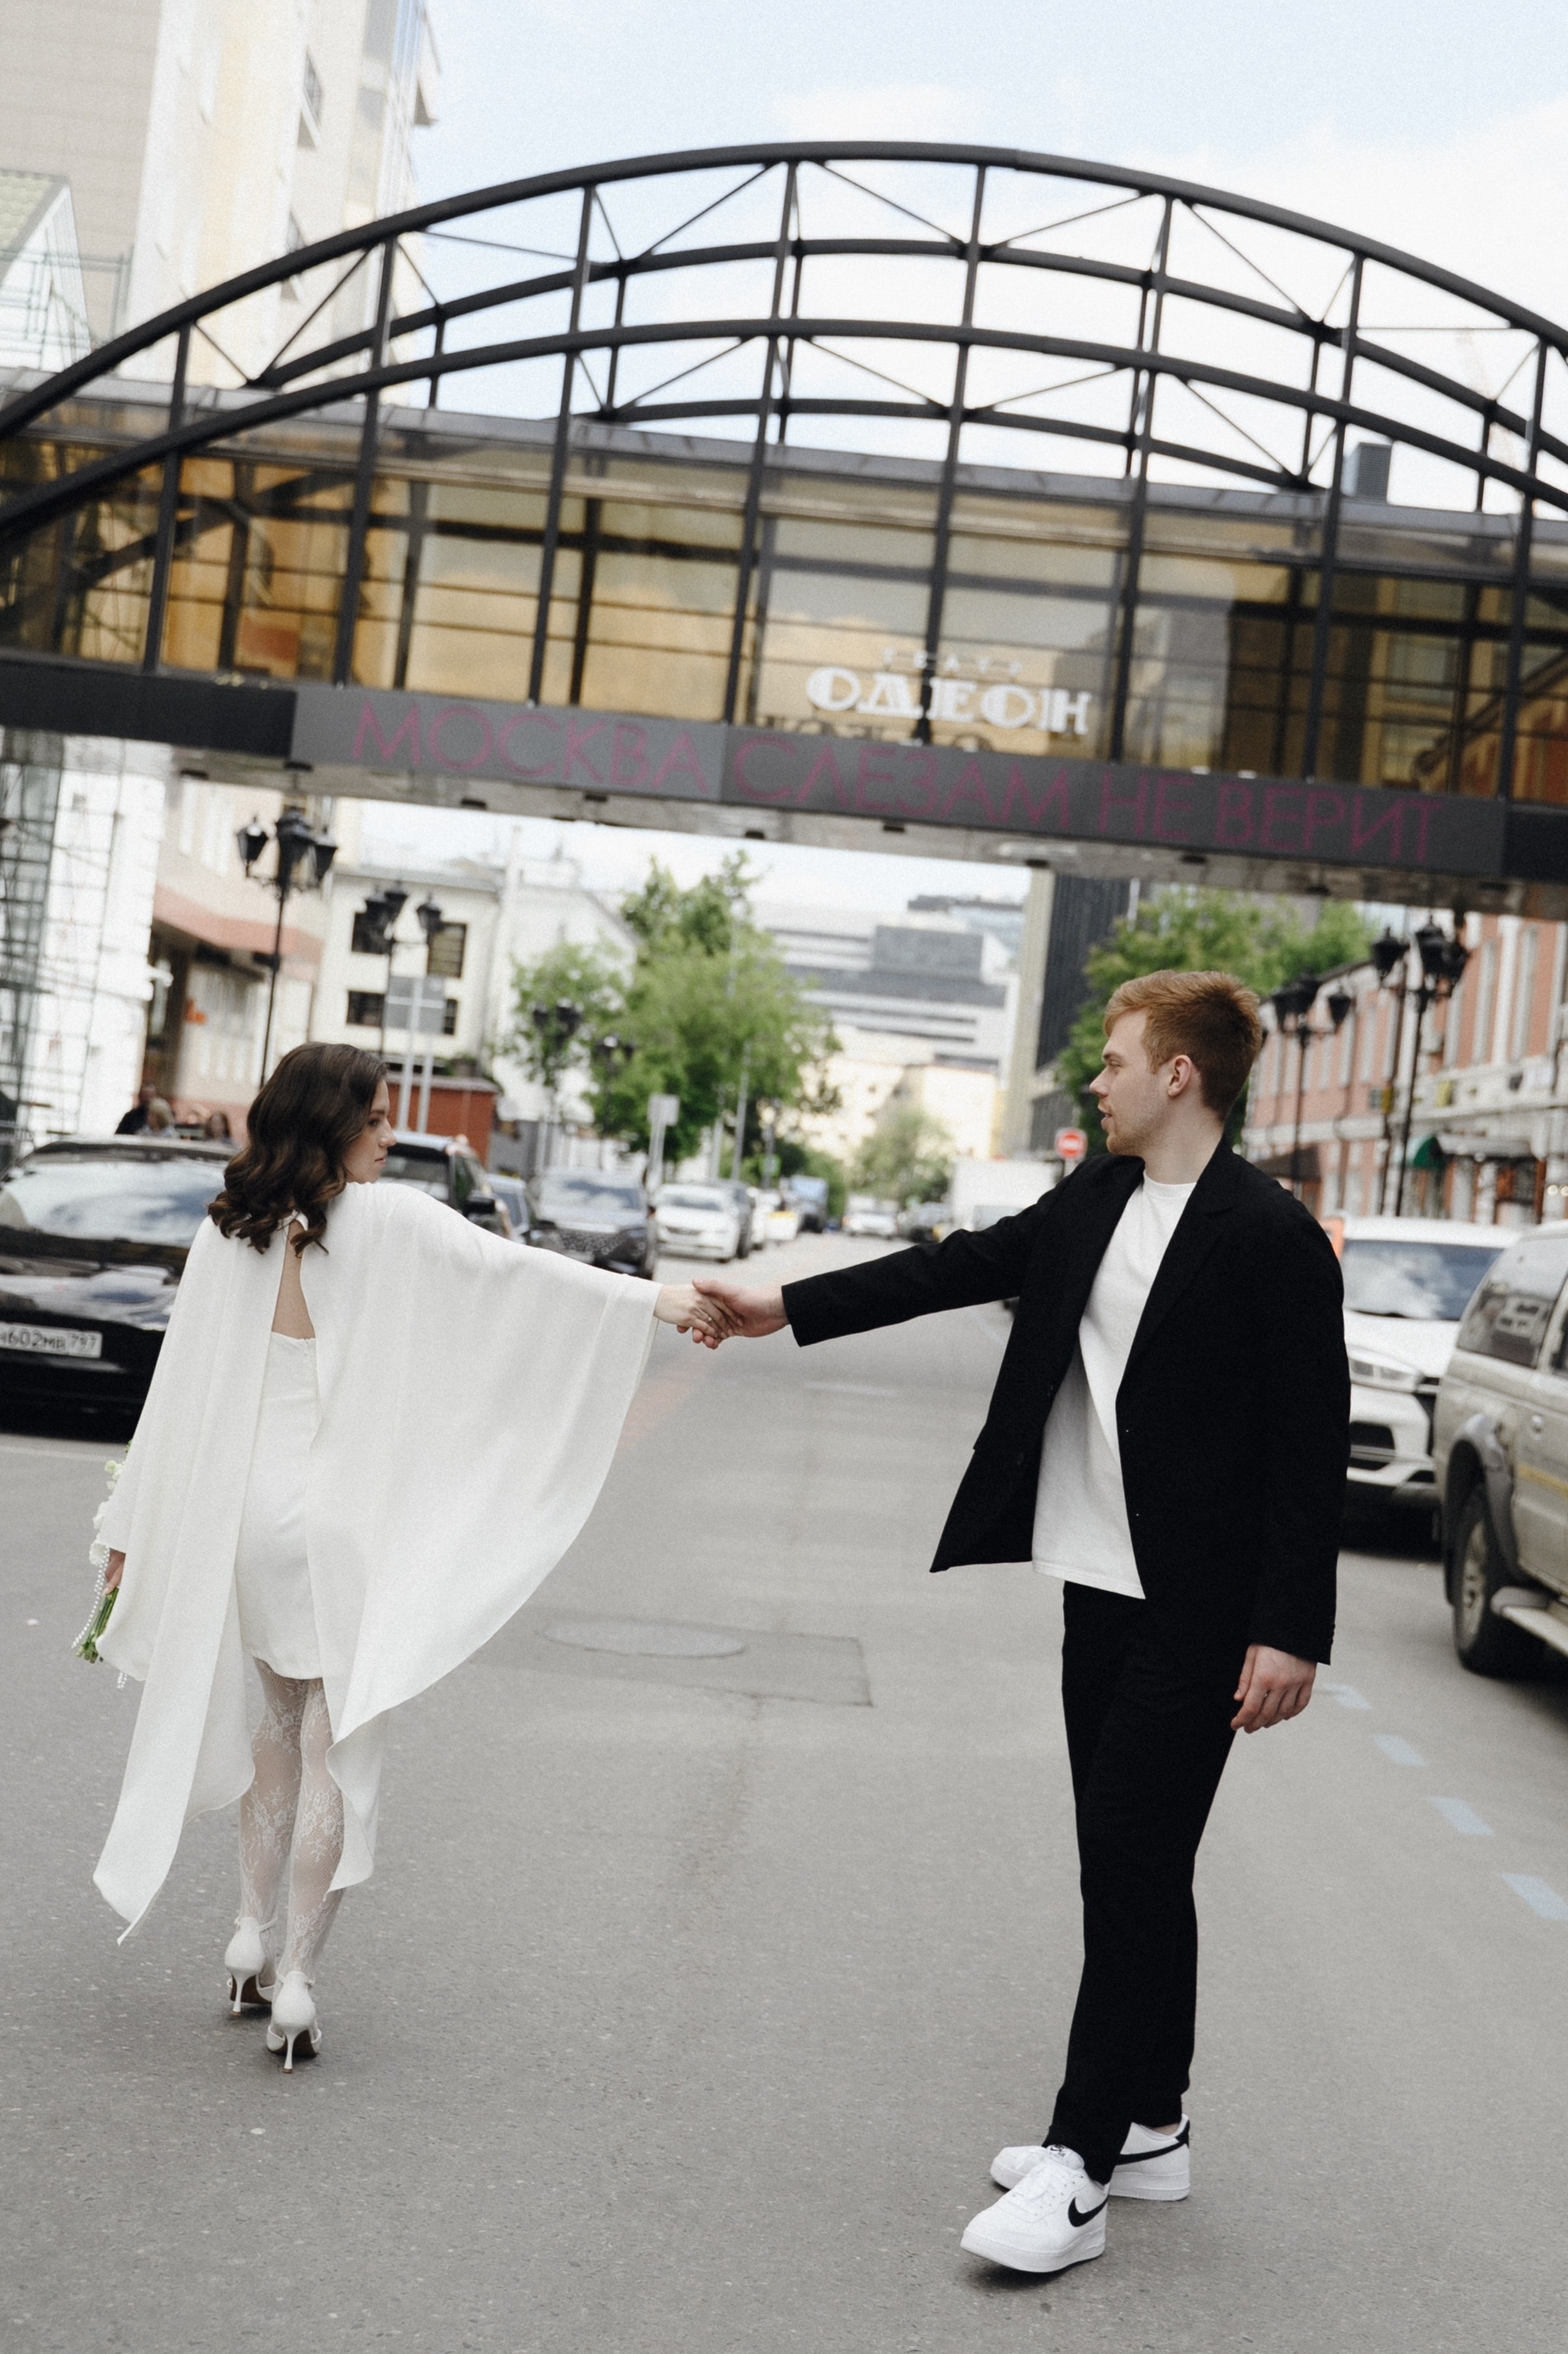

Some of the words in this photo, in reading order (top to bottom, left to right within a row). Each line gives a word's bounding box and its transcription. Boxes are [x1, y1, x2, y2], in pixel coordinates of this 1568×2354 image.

[805, 666, 1091, 735] ОДЕОН
[352, 700, 709, 794] МОСКВА
[732, 735, 1070, 829] СЛЕЗАМ
[1097, 769, 1196, 841] НЕ
[1215, 779, 1443, 863] ВЕРИТ
